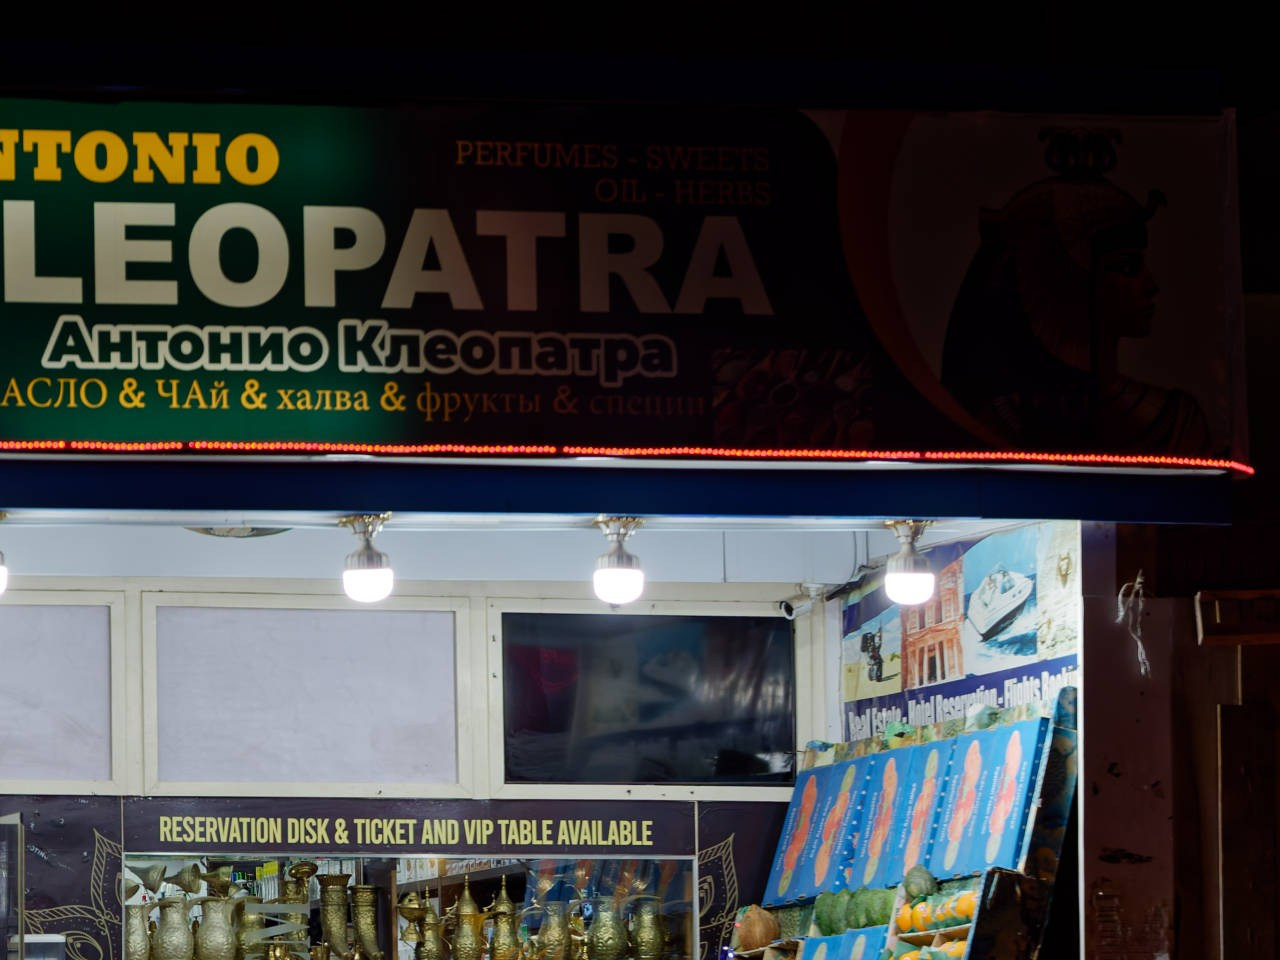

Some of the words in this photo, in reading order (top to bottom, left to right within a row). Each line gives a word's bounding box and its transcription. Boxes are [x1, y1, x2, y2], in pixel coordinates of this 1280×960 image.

[455, 138, 621, 171] PERFUMES
[645, 144, 770, 175] SWEETS
[593, 177, 647, 204] OIL
[673, 180, 773, 208] HERBS
[41, 315, 329, 374] Антонио
[338, 317, 680, 389] Клеопатра
[117, 378, 147, 410] &
[239, 380, 270, 412] &
[279, 384, 369, 413] халва
[379, 382, 408, 414] &
[416, 380, 543, 423] фрукты
[550, 384, 579, 416] &
[158, 815, 283, 846] RESERVATION
[288, 817, 329, 846] DISK
[333, 817, 349, 845] &
[354, 818, 417, 846] TICKET
[421, 818, 459, 846] AND
[462, 818, 494, 847] VIP
[499, 818, 552, 847] TABLE
[557, 820, 655, 849] AVAILABLE
